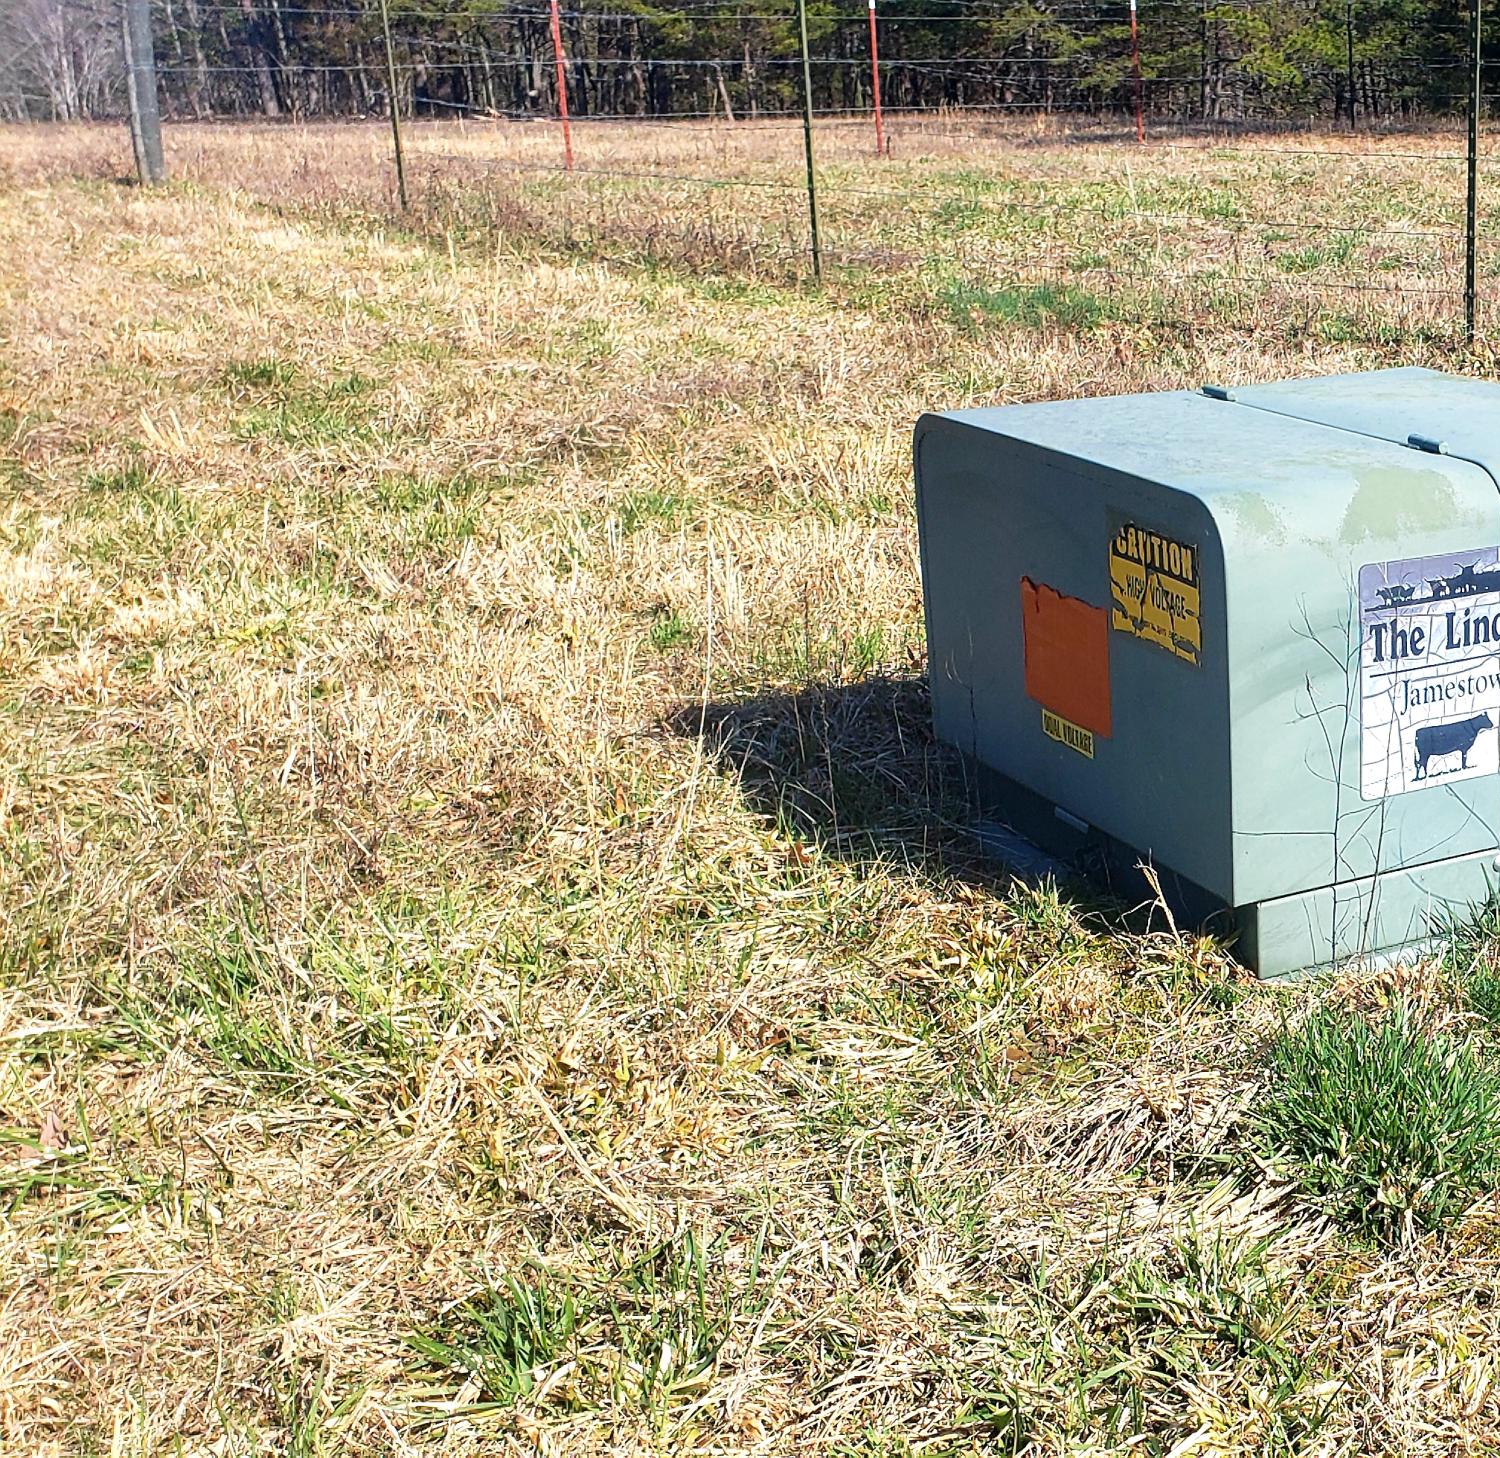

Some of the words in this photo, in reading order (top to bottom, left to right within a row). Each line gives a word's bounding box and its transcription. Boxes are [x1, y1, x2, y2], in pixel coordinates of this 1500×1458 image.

[1116, 526, 1193, 580] CAUTION
[1126, 574, 1145, 601] HIGH
[1150, 580, 1186, 620] VOLTAGE
[1369, 622, 1425, 662] The
[1062, 723, 1092, 754] VOLTAGE
